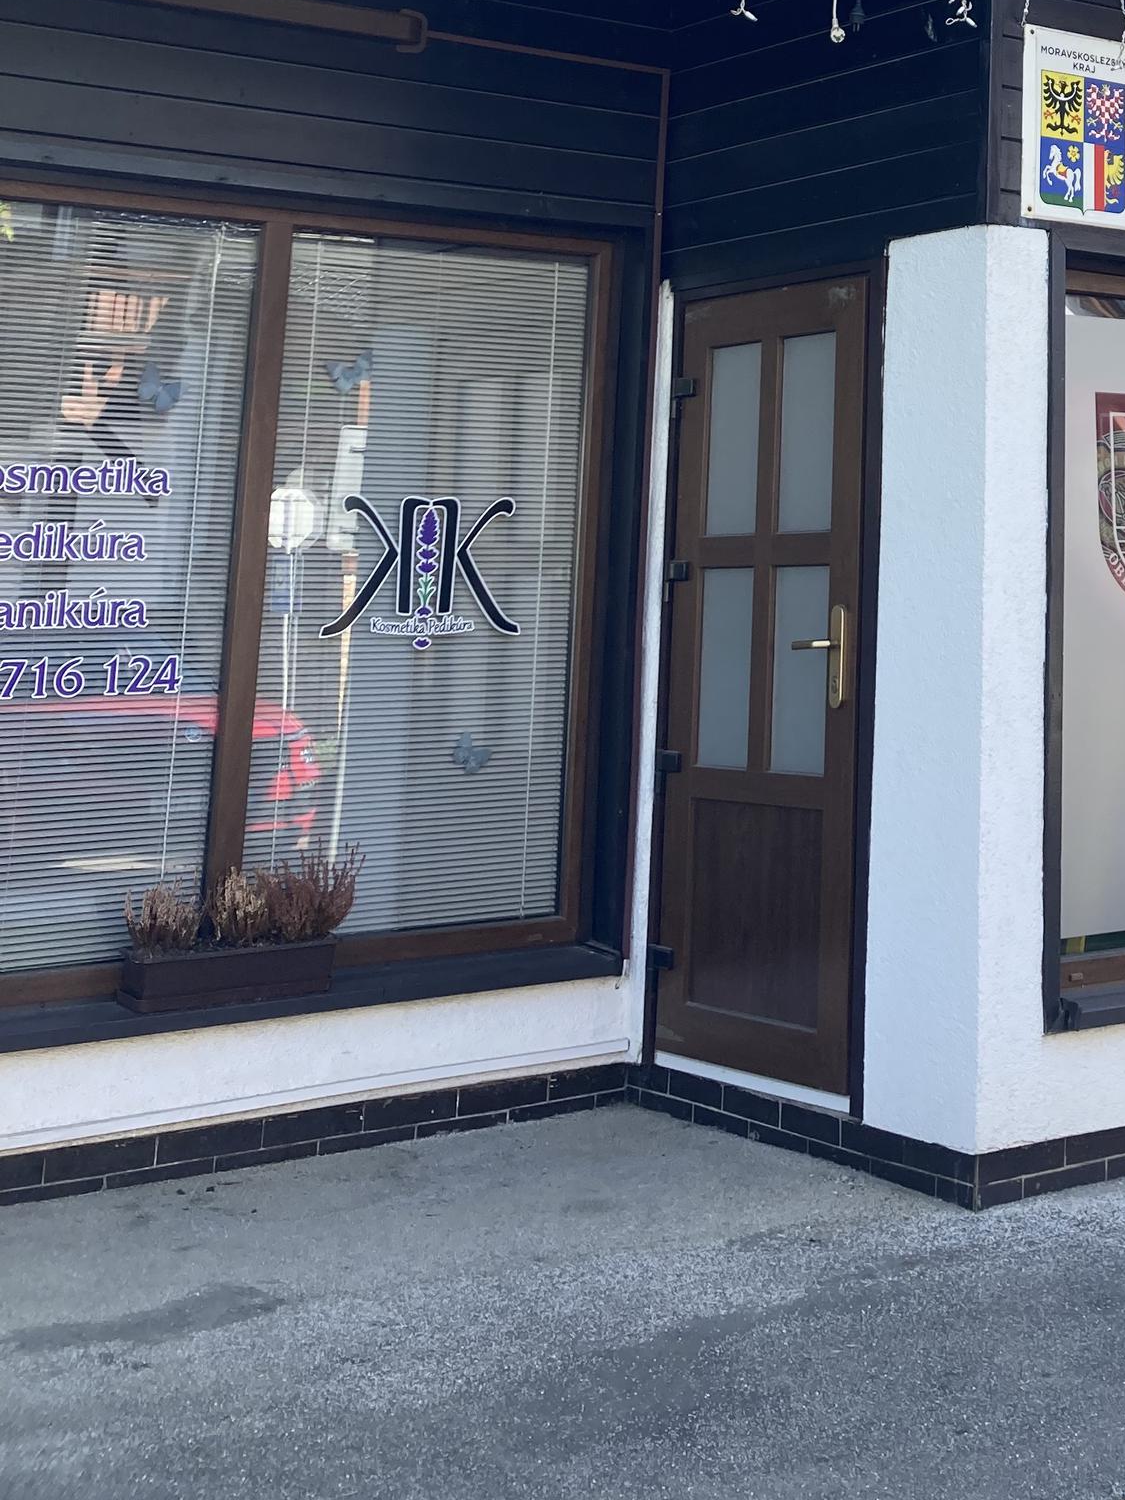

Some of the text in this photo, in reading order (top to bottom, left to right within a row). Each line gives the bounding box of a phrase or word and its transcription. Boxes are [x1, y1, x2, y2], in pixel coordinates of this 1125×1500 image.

[1072, 61, 1096, 74] KRAJ
[370, 615, 475, 635] Kosmetika Pedikúra
[103, 654, 183, 696] 124
